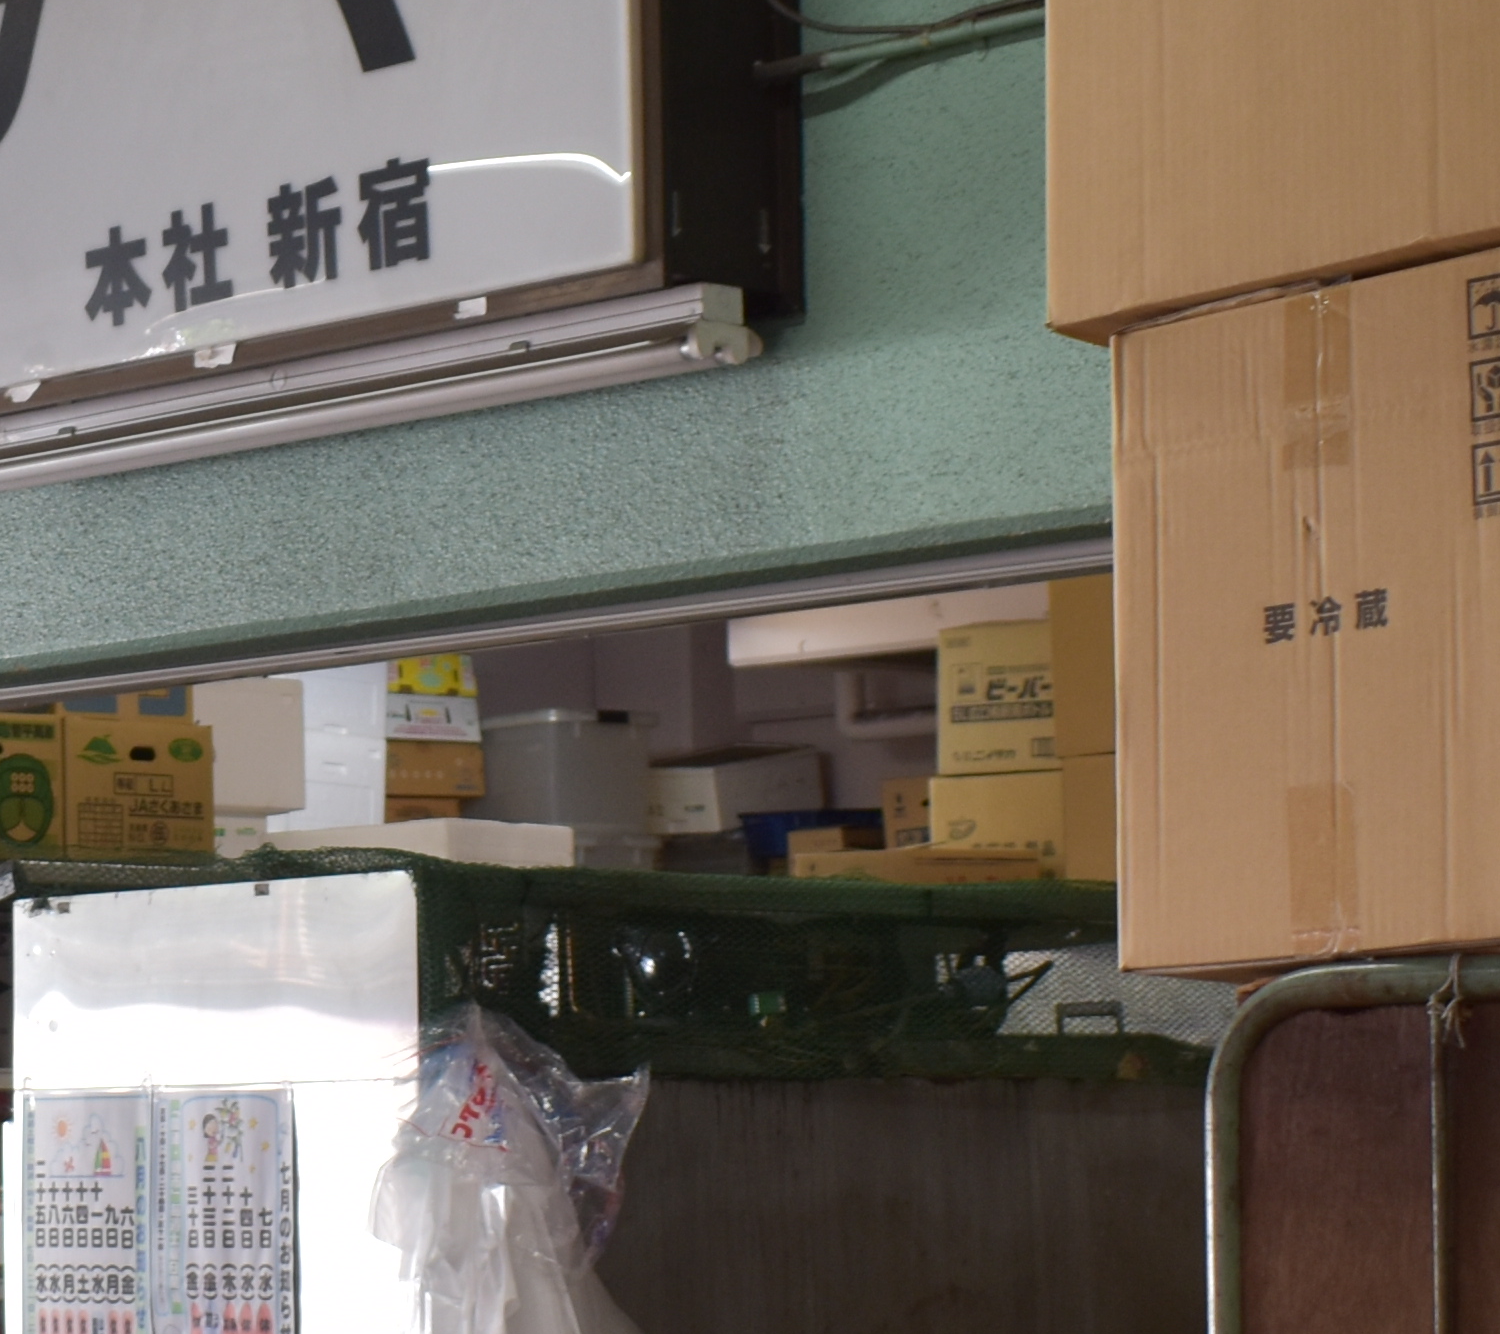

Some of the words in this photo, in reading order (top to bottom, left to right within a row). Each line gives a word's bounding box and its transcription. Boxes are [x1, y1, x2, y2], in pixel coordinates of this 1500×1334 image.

[1262, 588, 1390, 645] 要冷蔵
[986, 676, 1051, 699] ビーバー
